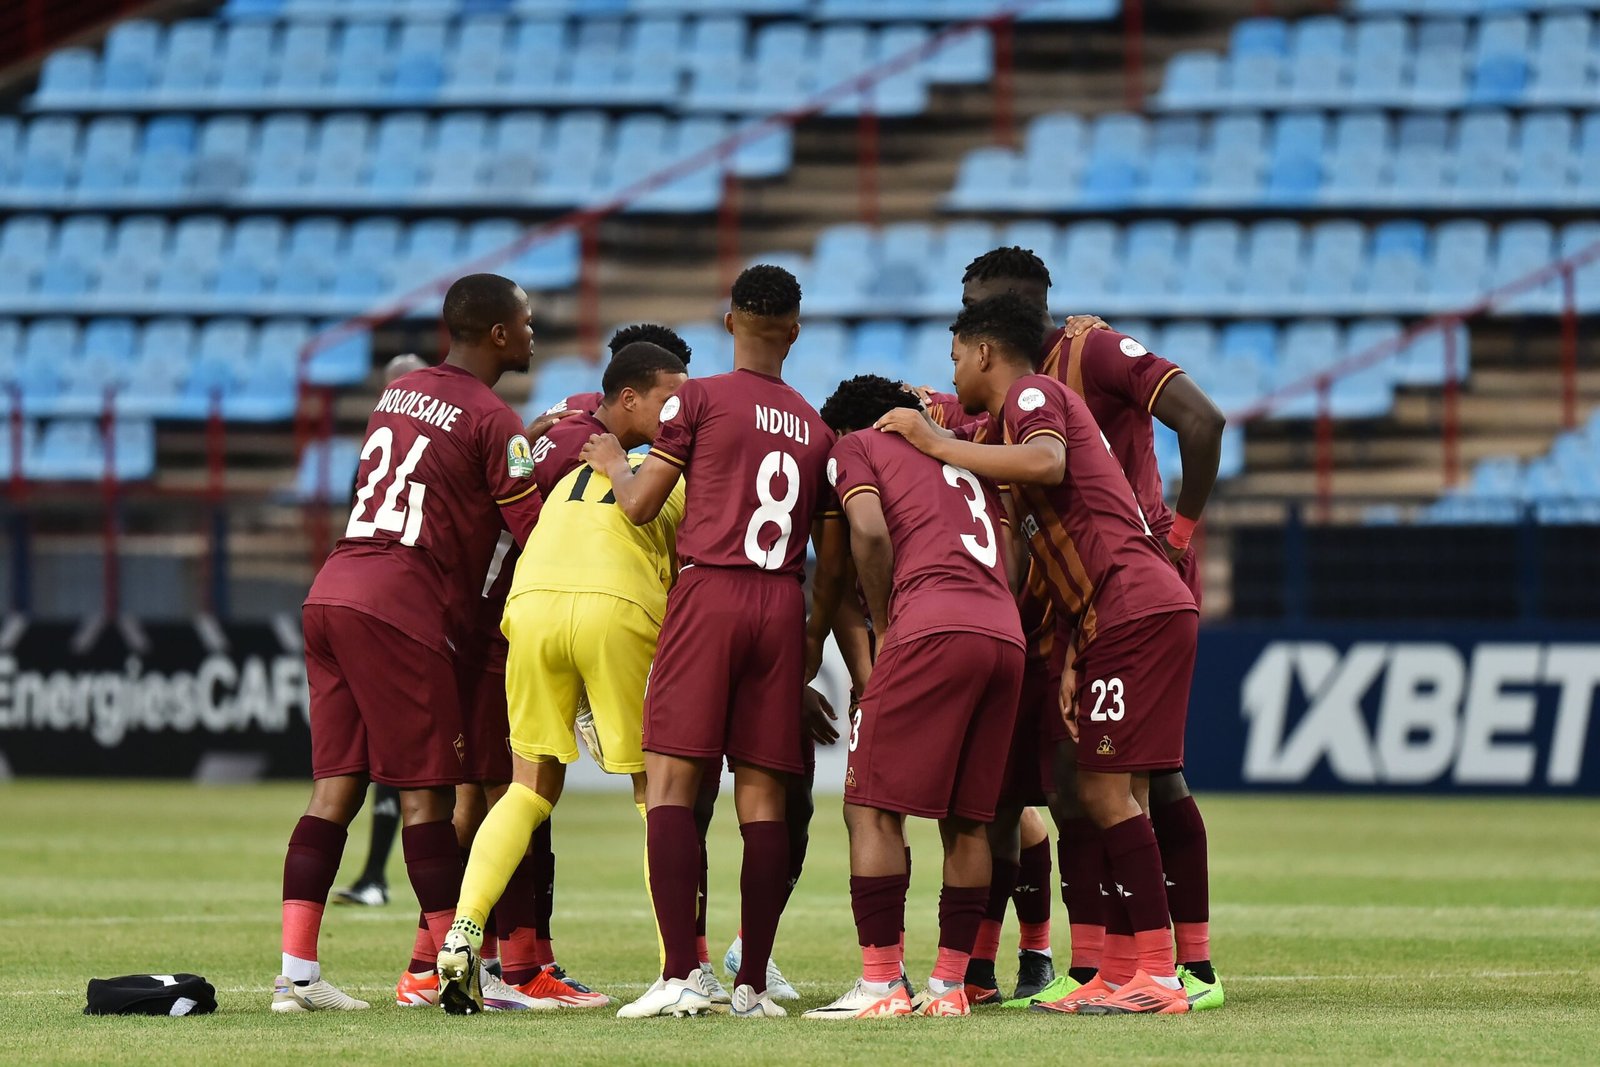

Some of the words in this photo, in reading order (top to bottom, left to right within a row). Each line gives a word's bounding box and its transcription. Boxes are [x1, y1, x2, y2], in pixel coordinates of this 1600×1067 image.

[373, 388, 463, 432] MOLOISANE
[755, 404, 809, 446] NDULI
[345, 426, 431, 547] 24
[744, 450, 800, 570] 8
[942, 464, 997, 568] 3
[1090, 677, 1125, 721] 23
[849, 708, 863, 752] 3
